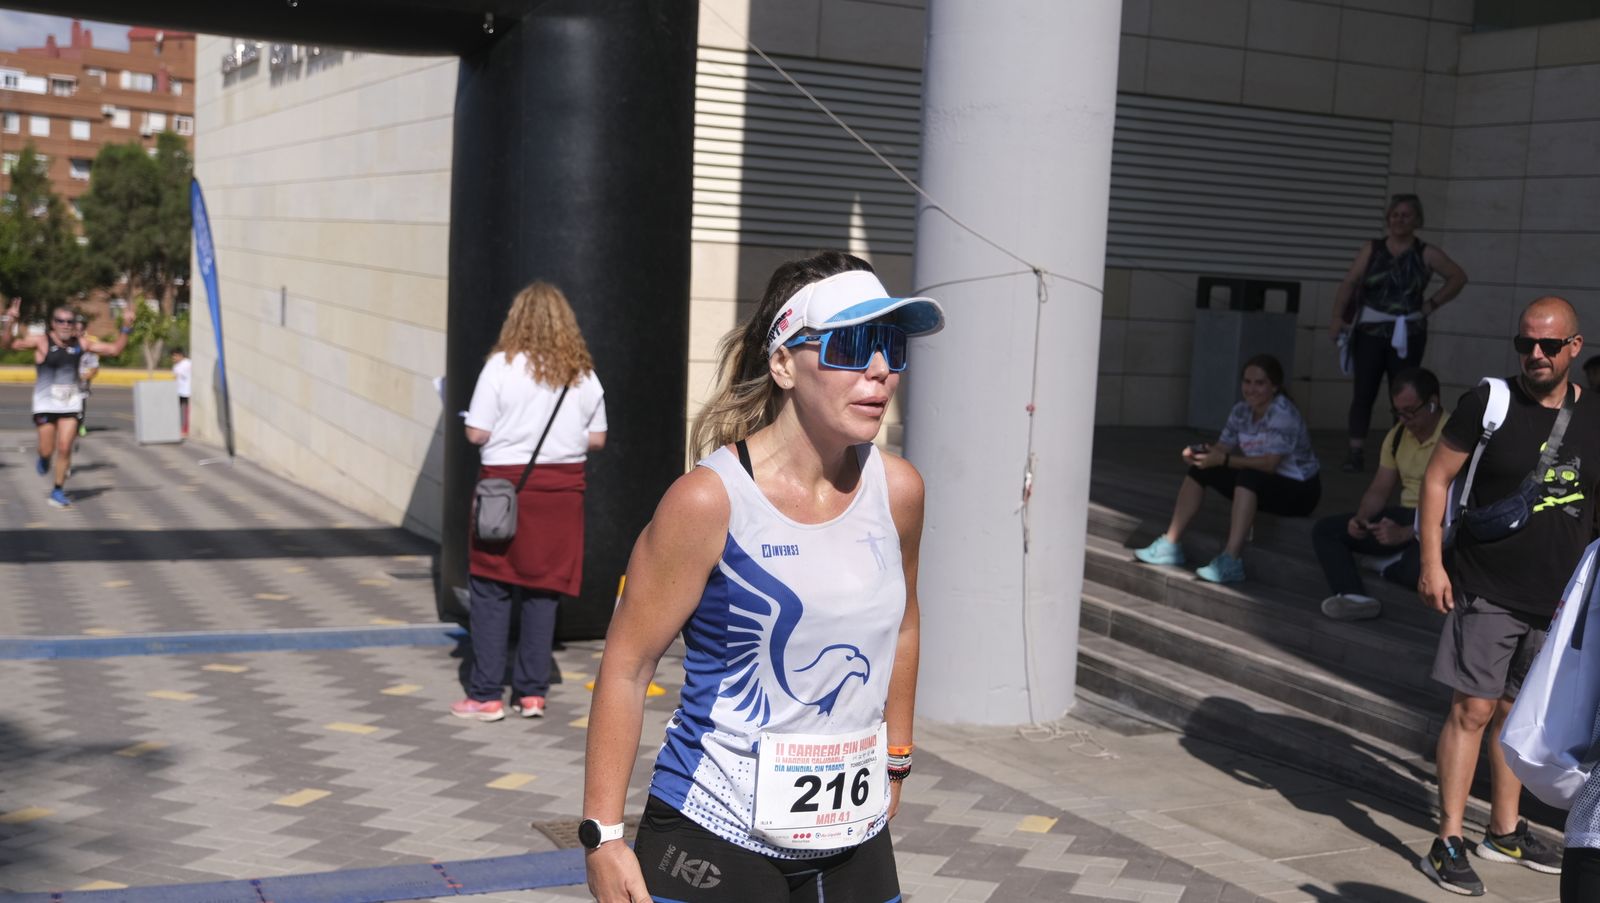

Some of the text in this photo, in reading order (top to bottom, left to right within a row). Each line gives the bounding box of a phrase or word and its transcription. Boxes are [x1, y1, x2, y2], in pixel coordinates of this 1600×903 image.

[776, 743, 784, 755] II
[788, 744, 840, 757] CARRERA
[843, 741, 858, 754] SIN
[860, 735, 876, 751] HUMO
[814, 764, 825, 773] SIN
[790, 767, 871, 813] 216
[816, 813, 836, 825] MAR
